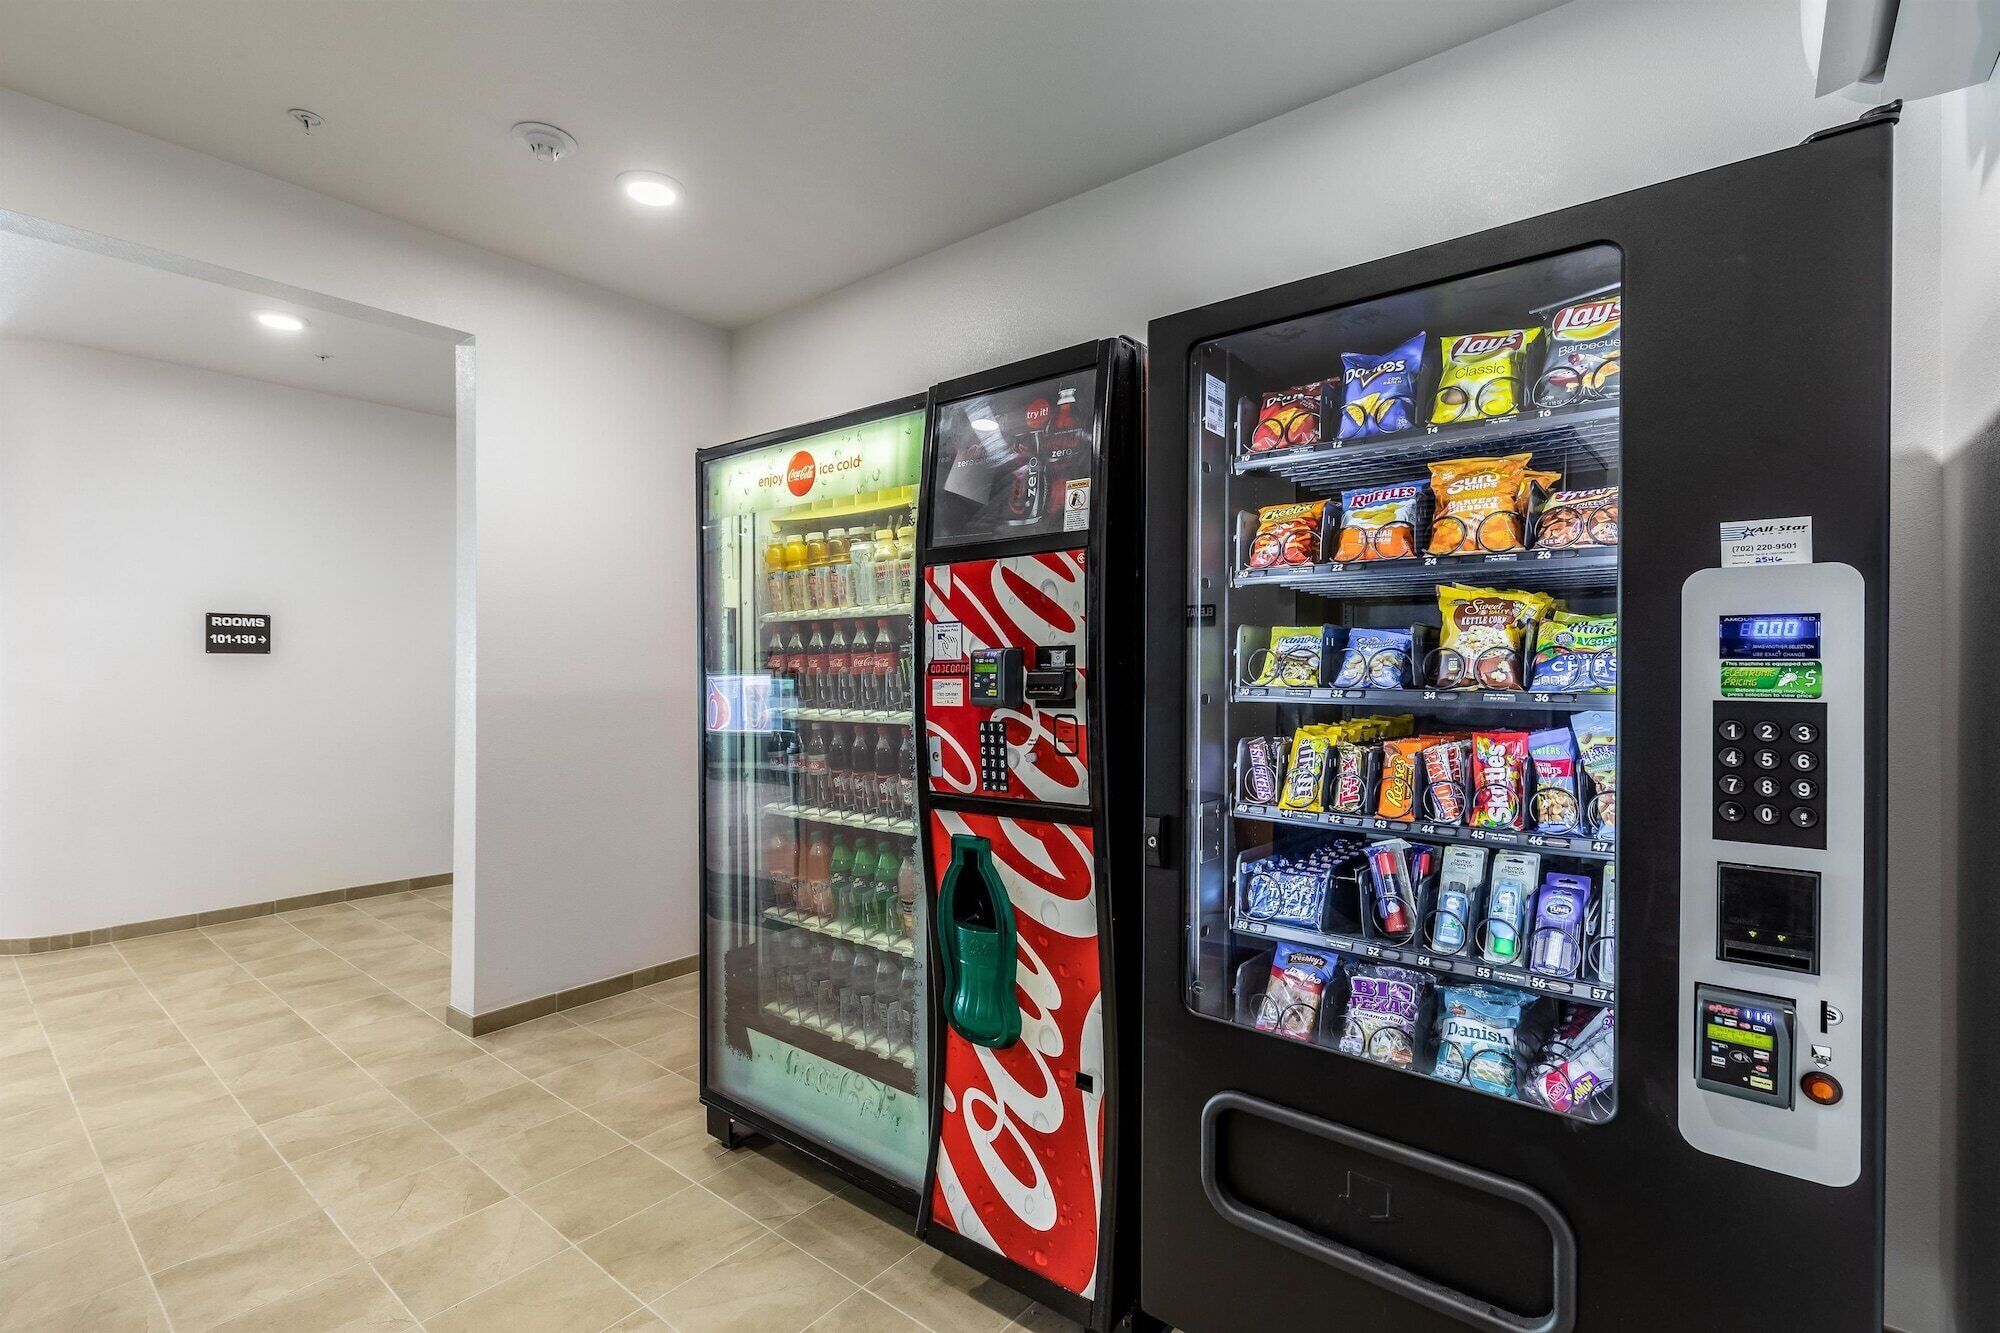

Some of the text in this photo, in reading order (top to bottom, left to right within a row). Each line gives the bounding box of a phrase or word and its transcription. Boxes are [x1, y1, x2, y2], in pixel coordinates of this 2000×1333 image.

[1558, 339, 1620, 357] Barbecue
[1455, 363, 1505, 379] Classic
[1026, 408, 1048, 420] try it!
[1538, 410, 1551, 418] 16
[1427, 426, 1438, 435] 14
[1052, 448, 1072, 458] zero
[957, 459, 973, 468] zero
[758, 474, 784, 487] enjoy
[820, 462, 834, 474] ice
[837, 455, 860, 471] cold
[1027, 456, 1038, 498] zero
[1350, 487, 1416, 507] RUFFLES
[1755, 525, 1809, 533] All-Star
[1756, 543, 1797, 551] 220-9501
[1538, 551, 1551, 559] 26
[1425, 558, 1437, 566] 24
[1332, 564, 1343, 572] 22
[211, 617, 265, 627] ROOMS
[1461, 616, 1507, 625] KETTLE CORN
[210, 634, 256, 644] 101-130
[1582, 635, 1616, 647] Veggi
[1724, 669, 1775, 677] ELECTRONIC
[1331, 690, 1343, 698] 32
[1423, 691, 1436, 700] 34
[1535, 693, 1549, 702] 36
[1727, 724, 1736, 737] 1
[1762, 725, 1773, 738] 2
[1798, 726, 1810, 740] 3
[1533, 746, 1561, 755] ANTERS
[1588, 745, 1610, 758] BLUE
[1584, 750, 1615, 766] DIAMON
[1726, 751, 1737, 764] 4
[1761, 753, 1773, 766] 5
[1797, 754, 1810, 768] 6
[1250, 749, 1272, 800] SNICKERS
[1537, 766, 1562, 775] ANUTS
[1727, 778, 1737, 792] 7
[1762, 780, 1773, 794] 8
[1798, 782, 1810, 796] 9
[1762, 808, 1773, 821] 0
[1800, 812, 1808, 820] #
[1375, 820, 1387, 828] 43
[1421, 825, 1434, 833] 44
[1471, 831, 1485, 839] 45
[1529, 837, 1543, 845] 46
[1593, 842, 1607, 851] 47
[1549, 905, 1570, 914] TUMS
[1368, 947, 1379, 956] 52
[1418, 957, 1430, 966] 54
[1477, 967, 1490, 977] 55
[1532, 977, 1545, 988] 56
[1353, 978, 1412, 1002] BIG
[1593, 990, 1607, 999] 57
[1350, 996, 1415, 1020] TEXAS
[1709, 1004, 1739, 1015] ePort
[1353, 1010, 1404, 1024] Cinnamon Roll
[1447, 1021, 1511, 1046] Danish
